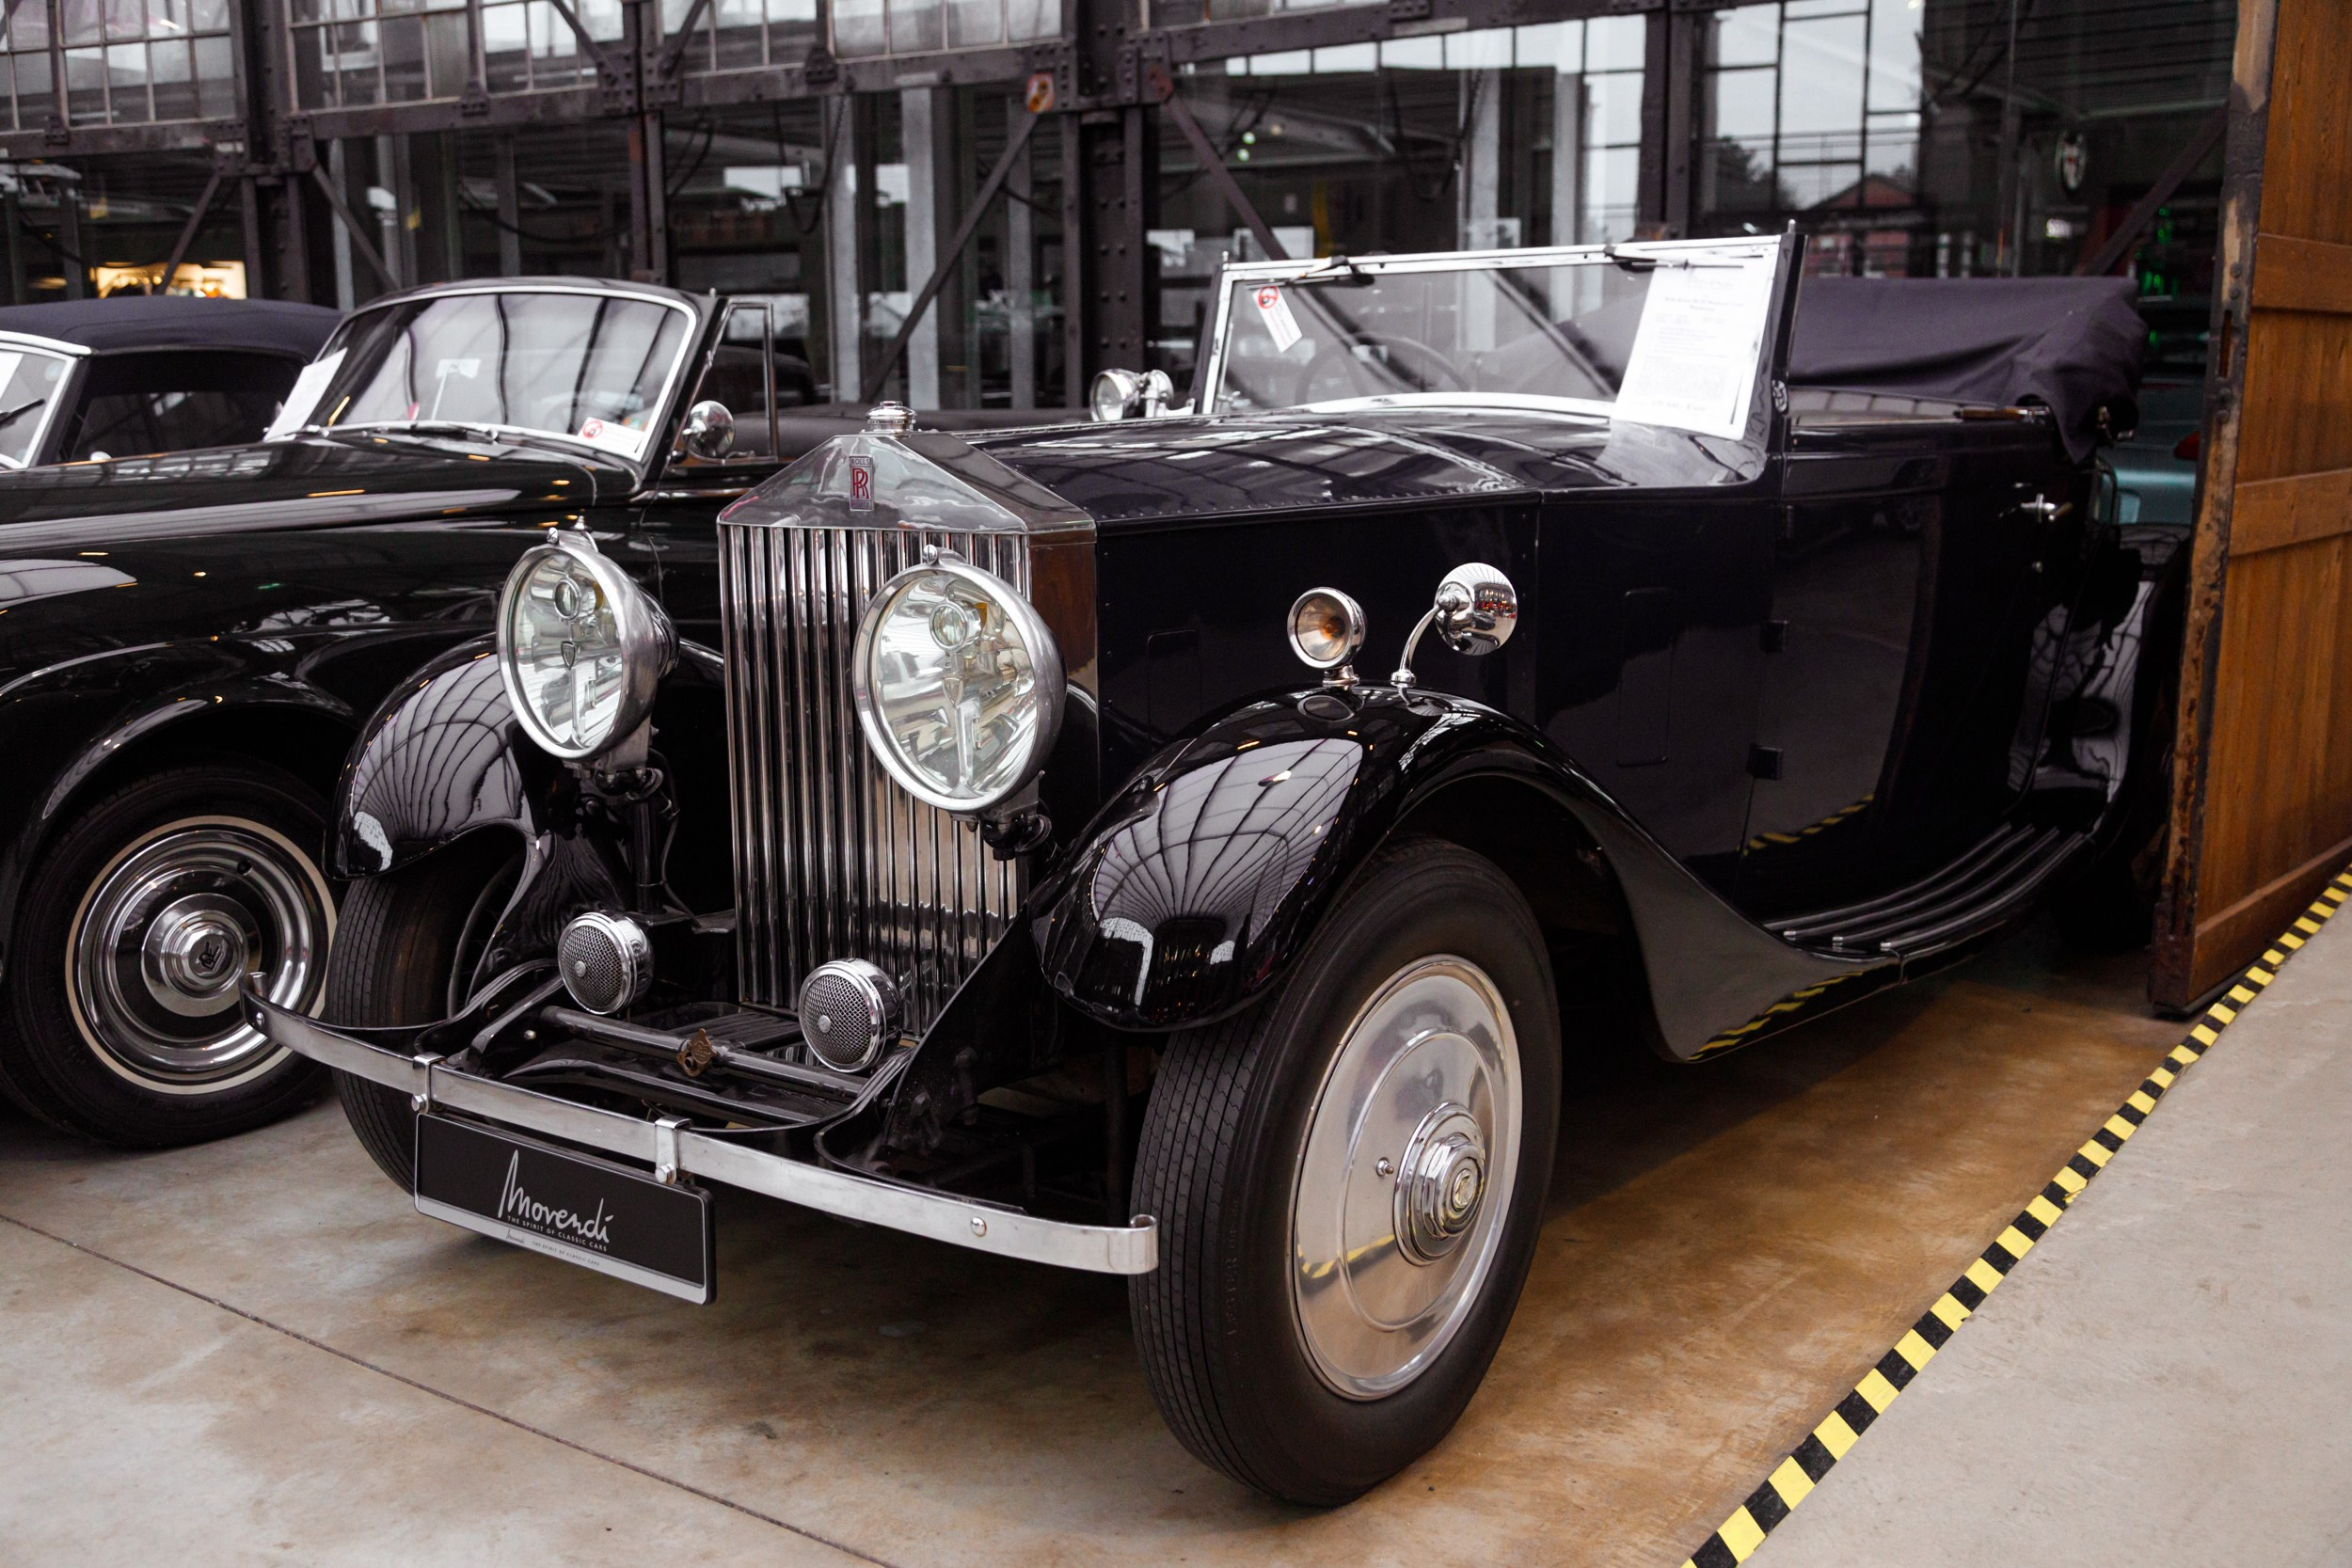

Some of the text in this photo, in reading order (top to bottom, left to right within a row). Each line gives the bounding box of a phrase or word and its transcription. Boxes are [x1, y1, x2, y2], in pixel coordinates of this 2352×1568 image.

[508, 1215, 519, 1225] THE
[522, 1220, 544, 1232] SPIRIT
[558, 1231, 586, 1245] CLASSIC
[589, 1241, 607, 1252] CARS
